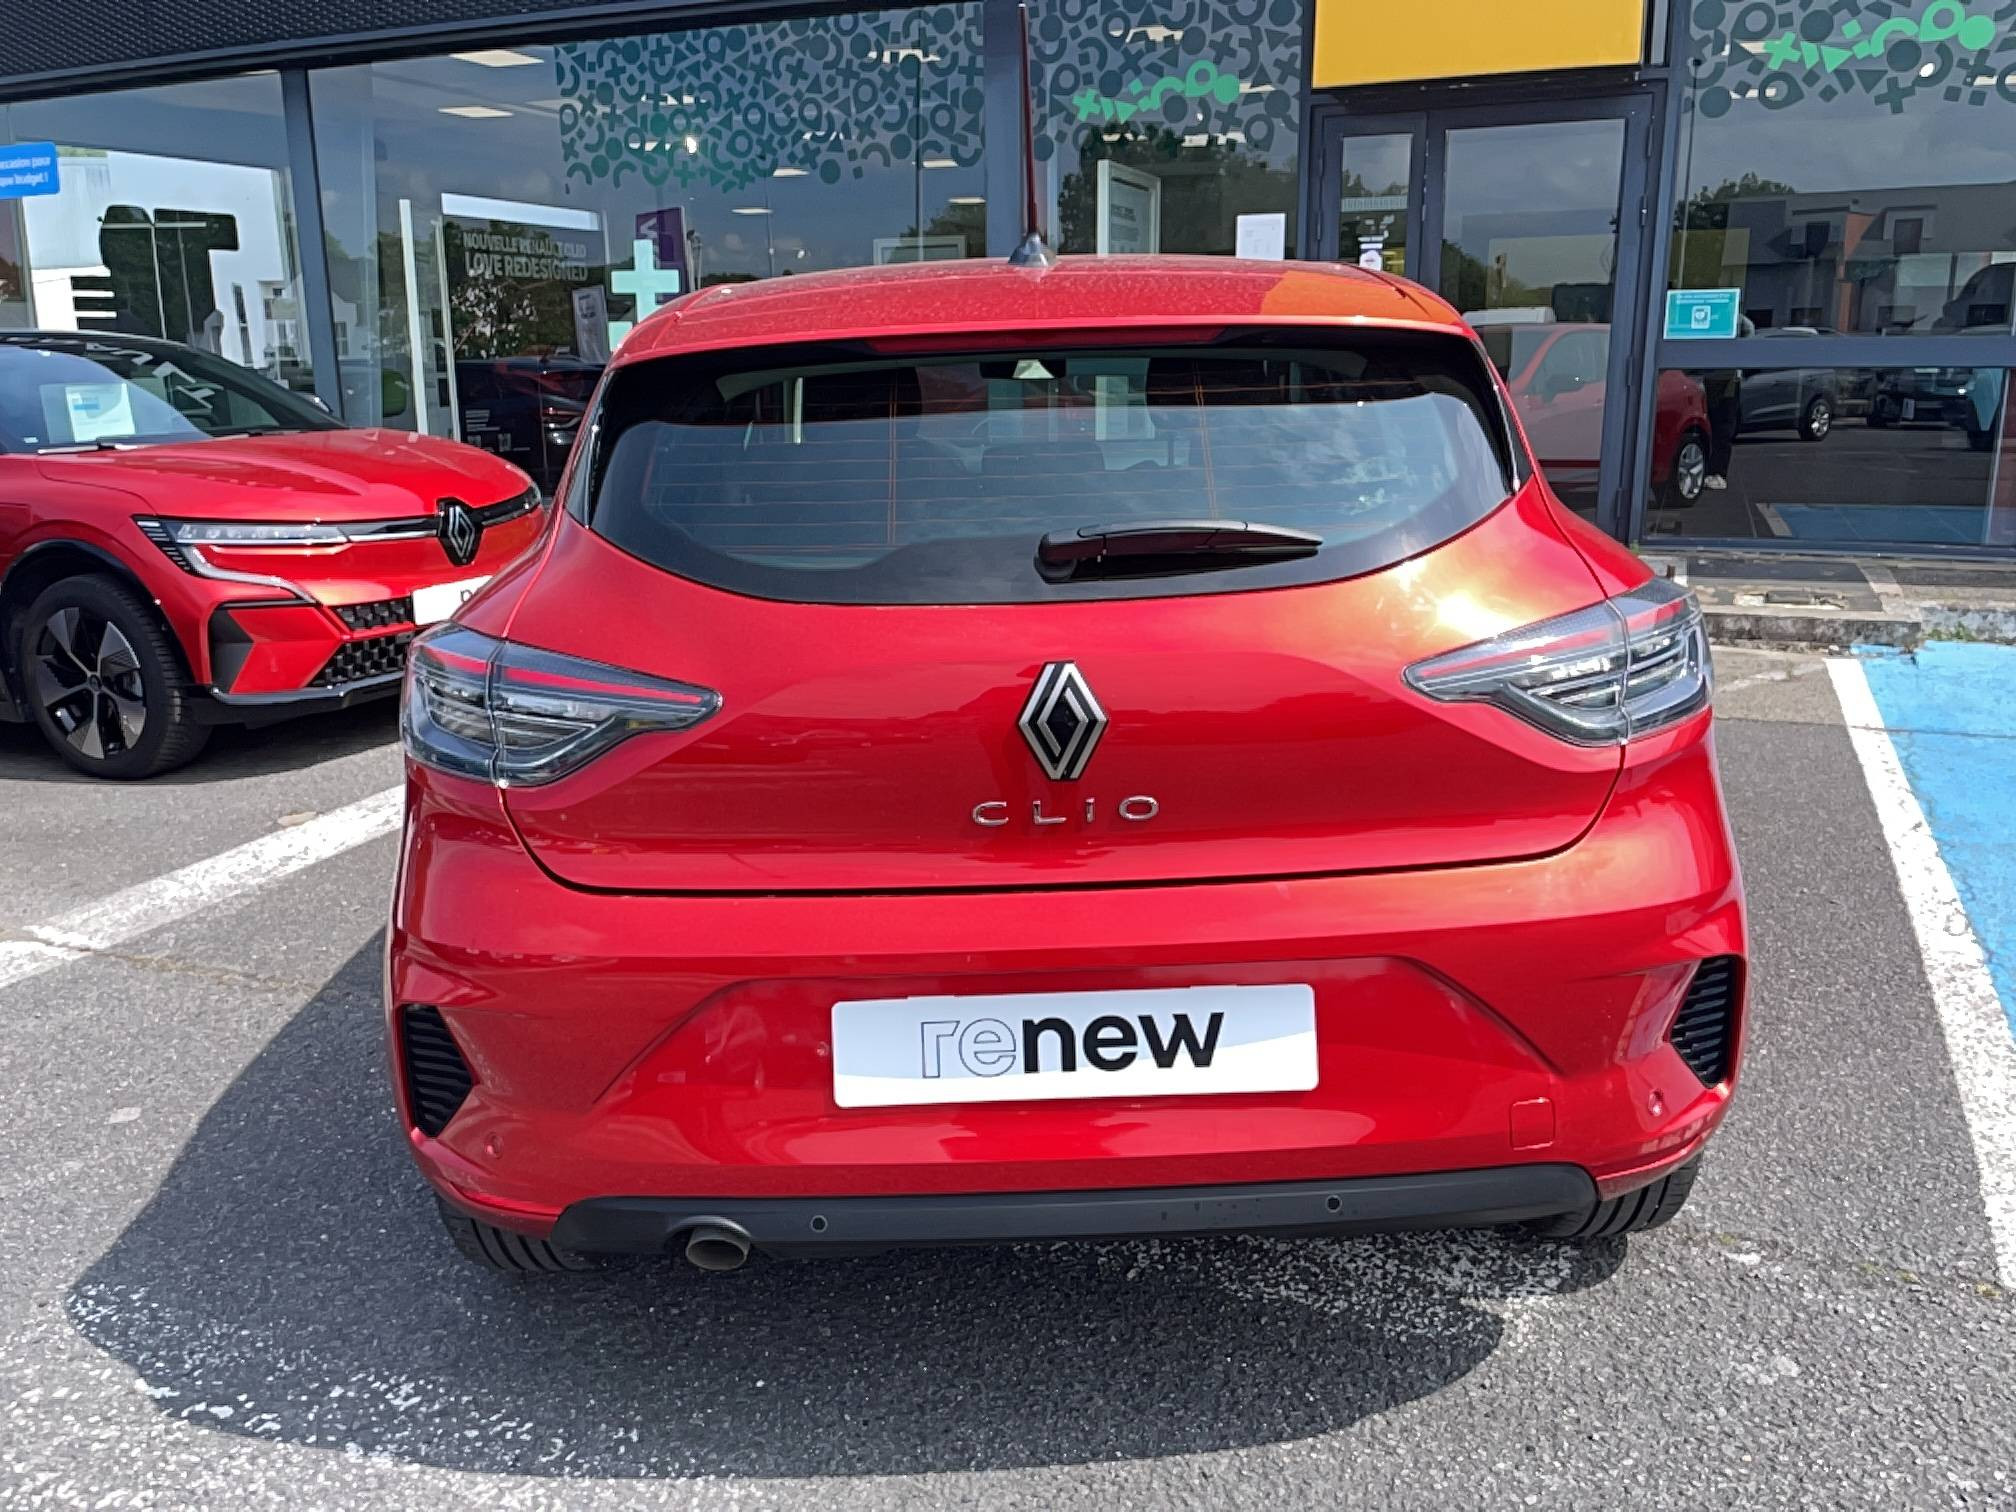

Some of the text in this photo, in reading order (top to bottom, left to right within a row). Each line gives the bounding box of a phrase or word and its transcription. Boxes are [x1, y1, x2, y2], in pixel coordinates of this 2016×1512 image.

[464, 251, 588, 281] LOVE REDESIGNED
[920, 1010, 1225, 1080] renew
